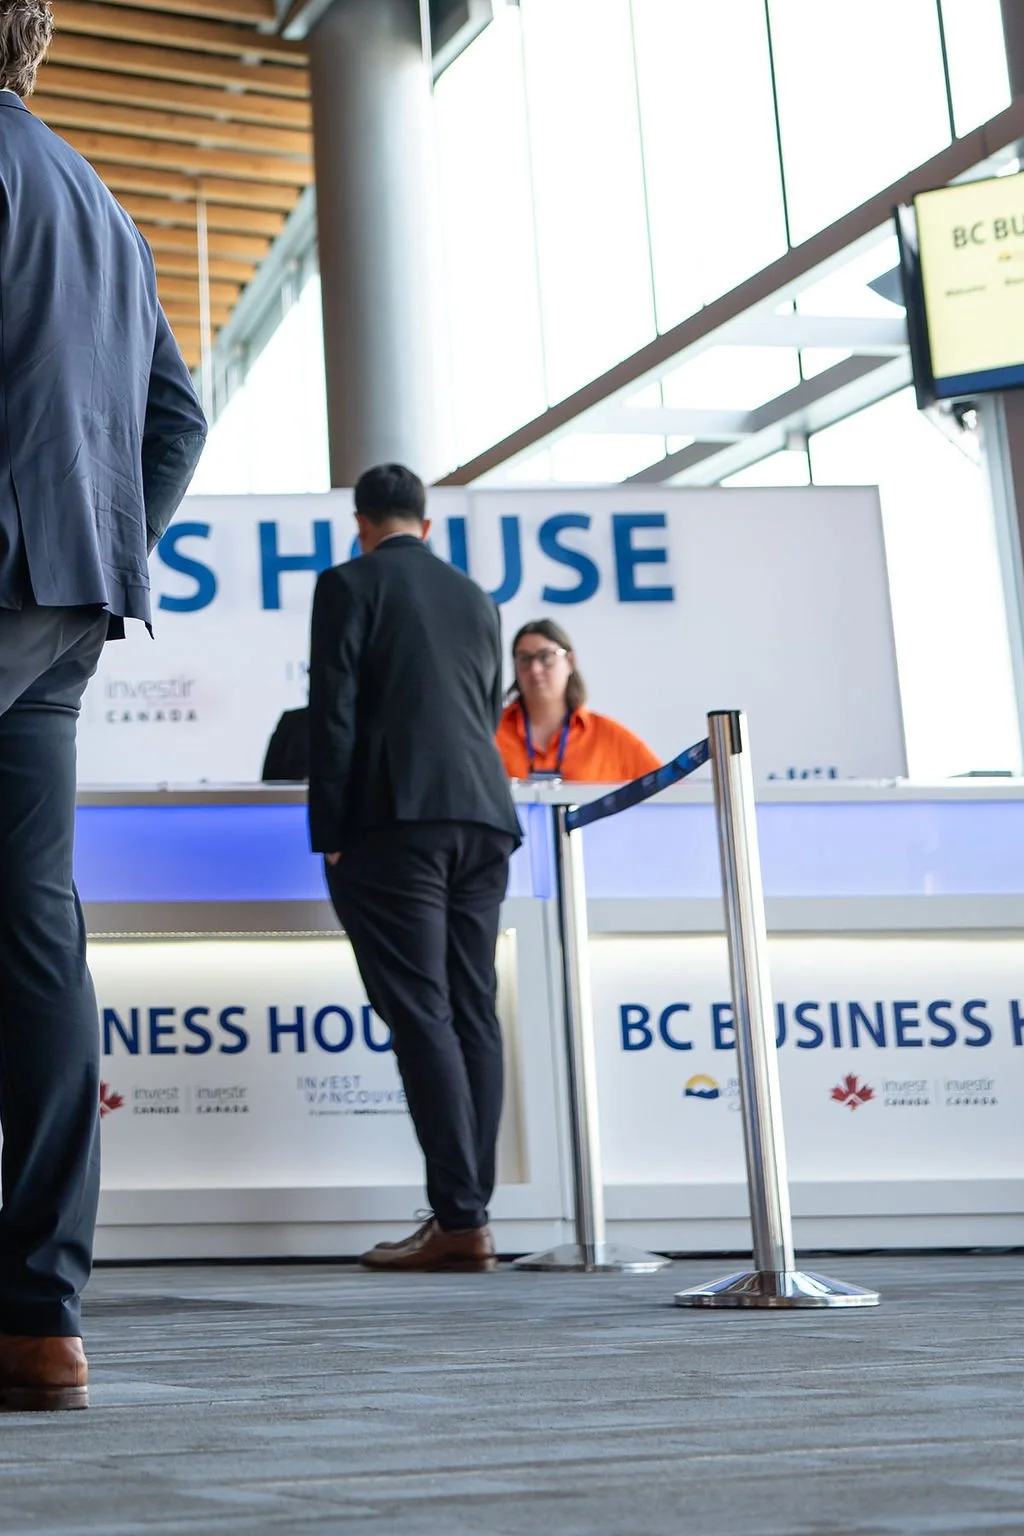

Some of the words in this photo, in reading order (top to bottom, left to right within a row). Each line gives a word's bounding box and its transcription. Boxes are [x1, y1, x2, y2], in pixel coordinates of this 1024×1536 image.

[953, 221, 986, 249] BC
[258, 512, 675, 611] HUSE
[619, 1002, 694, 1051] BC
[306, 1090, 407, 1104] VANCOUVE
